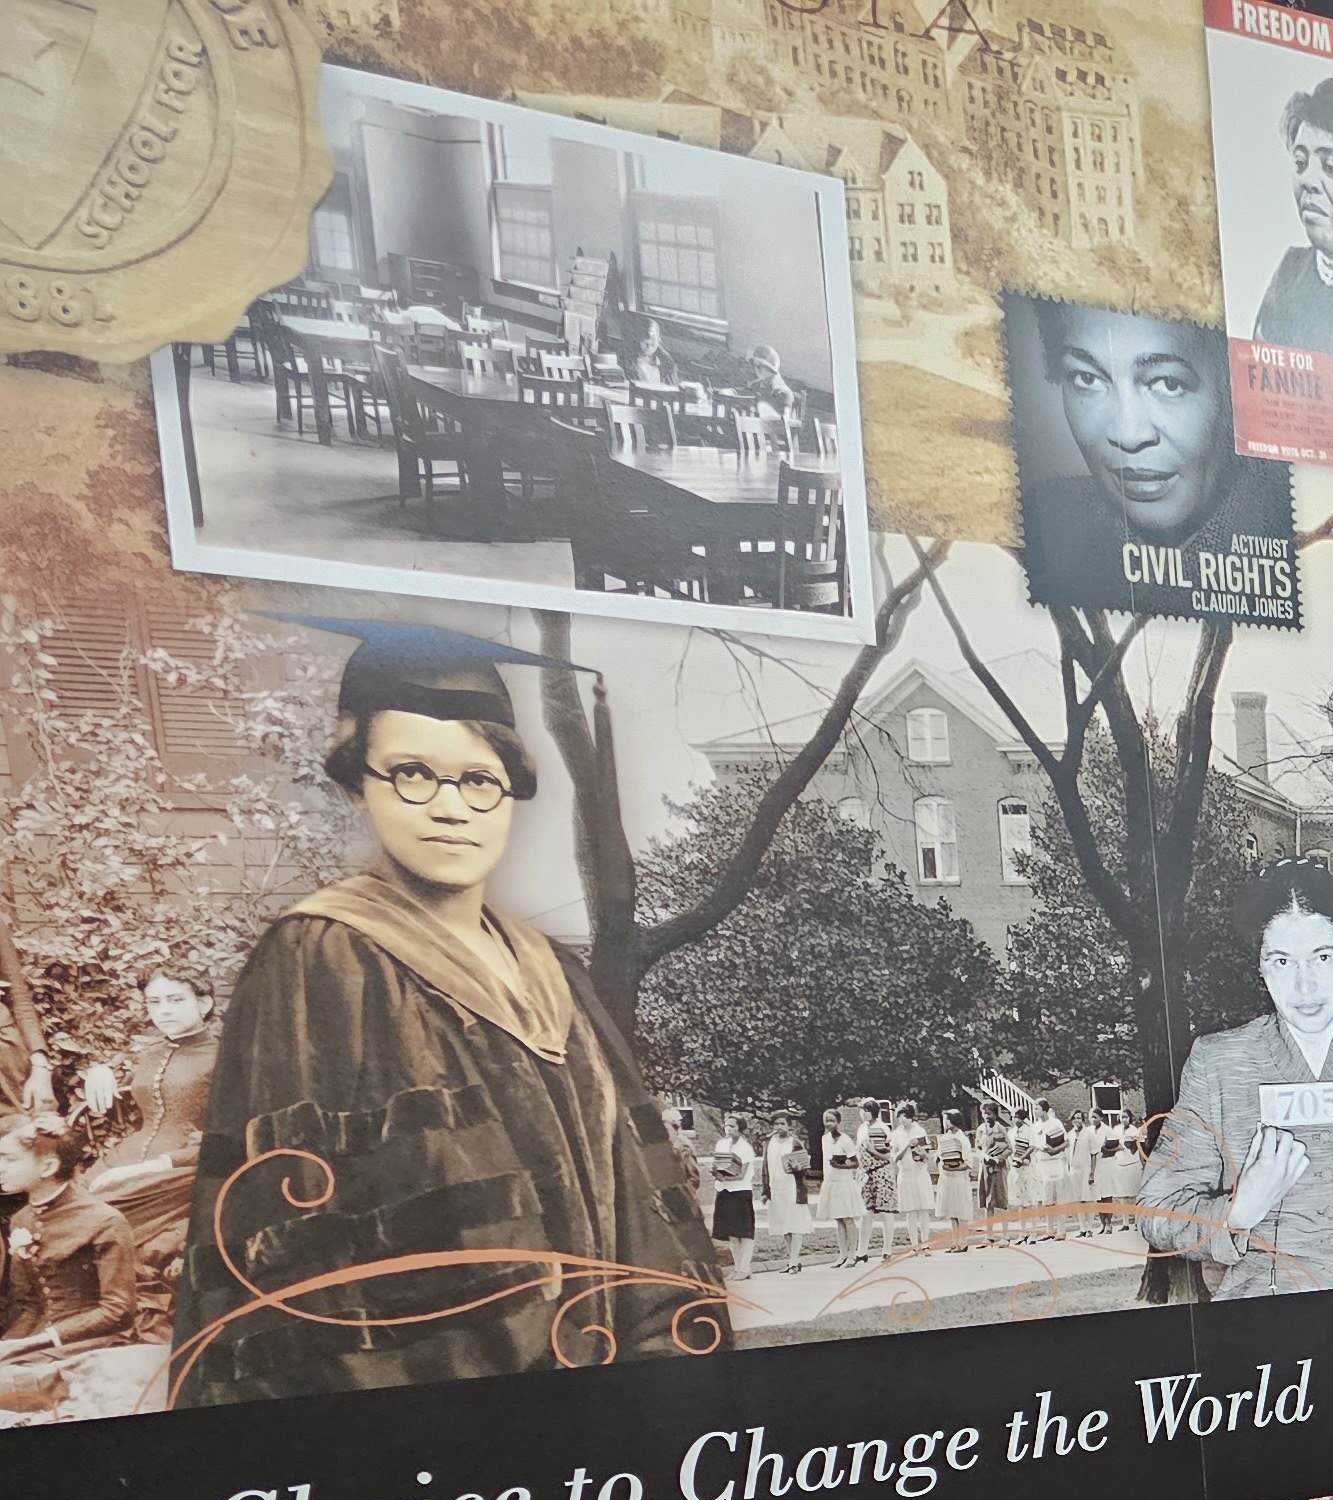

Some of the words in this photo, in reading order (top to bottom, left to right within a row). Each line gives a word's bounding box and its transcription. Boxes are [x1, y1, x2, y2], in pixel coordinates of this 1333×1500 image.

[1232, 0, 1331, 52] FREEDOM
[76, 114, 178, 250] SCHOOL
[152, 37, 206, 114] FOR
[1252, 345, 1285, 368] VOTE
[1289, 352, 1314, 372] FOR
[1248, 364, 1326, 400] FANNIE
[1231, 533, 1289, 559] ACTIVIST
[1122, 542, 1193, 588] CIVIL
[1199, 551, 1292, 598] RIGHTS
[1191, 590, 1249, 616] CLAUDIA
[1252, 597, 1294, 620] JONES
[1005, 1390, 1110, 1463] the
[1134, 1359, 1314, 1443] World
